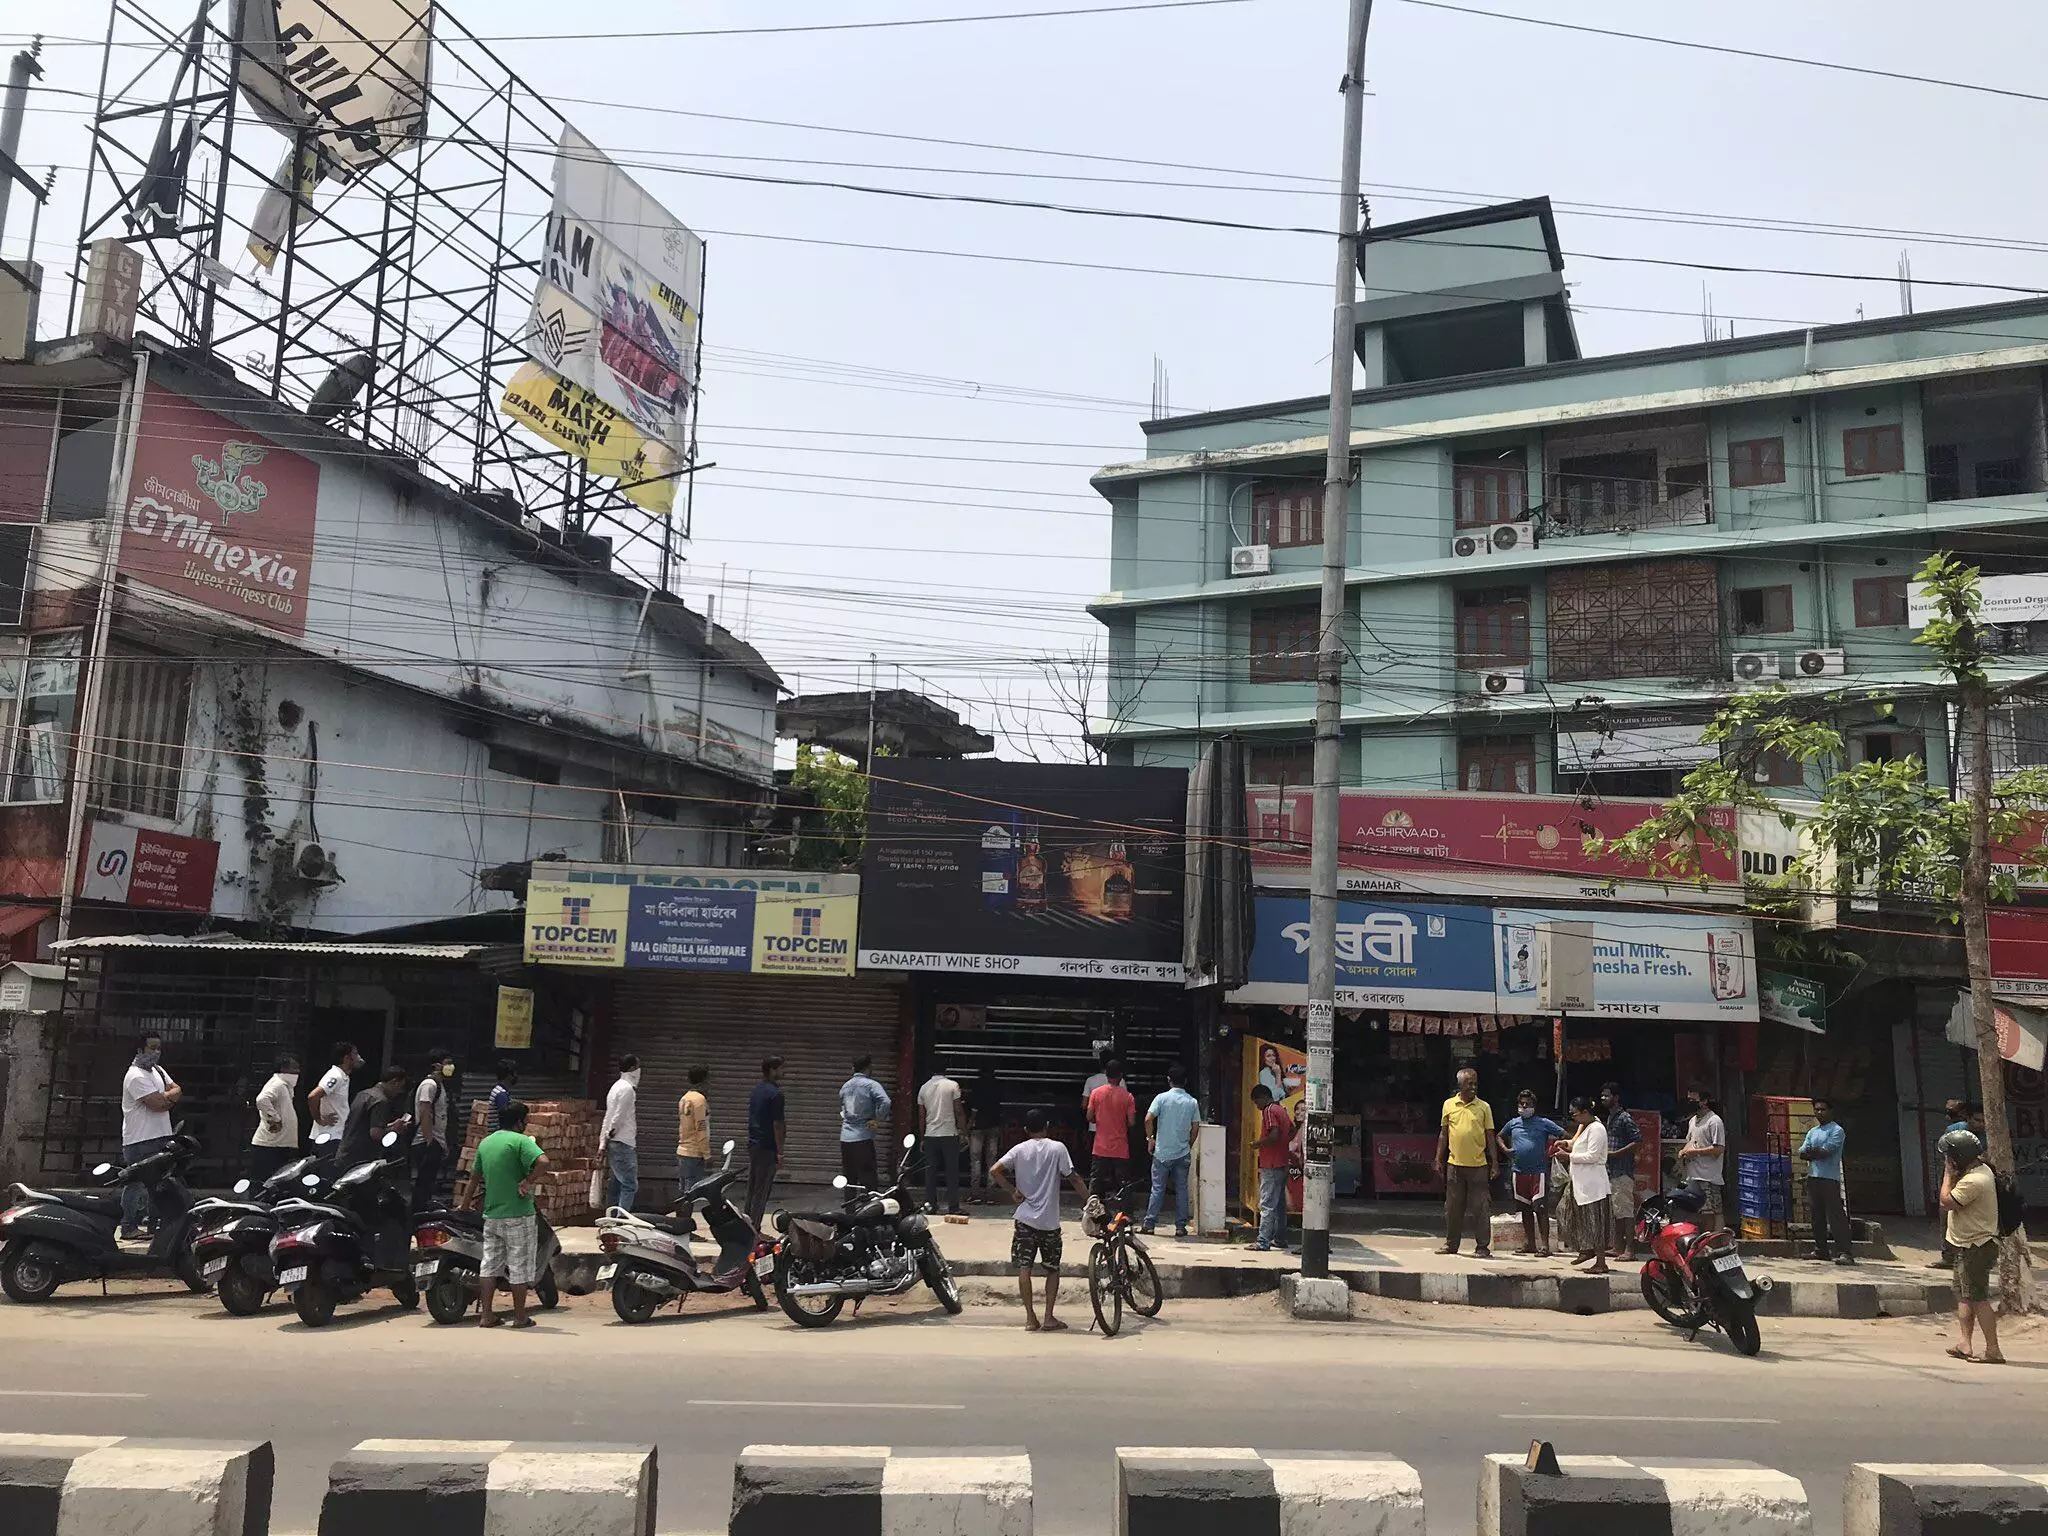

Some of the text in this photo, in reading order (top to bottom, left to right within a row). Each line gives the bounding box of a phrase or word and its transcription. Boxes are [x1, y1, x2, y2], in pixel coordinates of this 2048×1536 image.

[105, 251, 134, 341] GYM
[658, 282, 689, 314] ENTRY
[183, 561, 293, 615] Unisex Fitness Club
[1984, 597, 2022, 606] Control
[1356, 826, 1439, 839] AASHIRVAAD
[133, 879, 179, 892] Union Bank
[1346, 879, 1401, 890] SAMAHAR
[644, 904, 656, 916] মা
[532, 925, 617, 944] TOPCEM
[535, 944, 612, 954] CEMENT
[631, 941, 747, 957] MAA GIRIBALA HARDWARE
[764, 936, 848, 954] TOPCEM
[1593, 942, 1670, 959] mul Milk.
[681, 956, 697, 964] NEAR
[767, 954, 842, 964] CEMENT
[869, 952, 1020, 970] GANAPATTI WINE SHOP
[1060, 960, 1104, 974] গনপতি
[1644, 961, 1692, 977] Fresh.
[1787, 985, 1816, 999] MASTI
[1310, 1003, 1332, 1012] PAN
